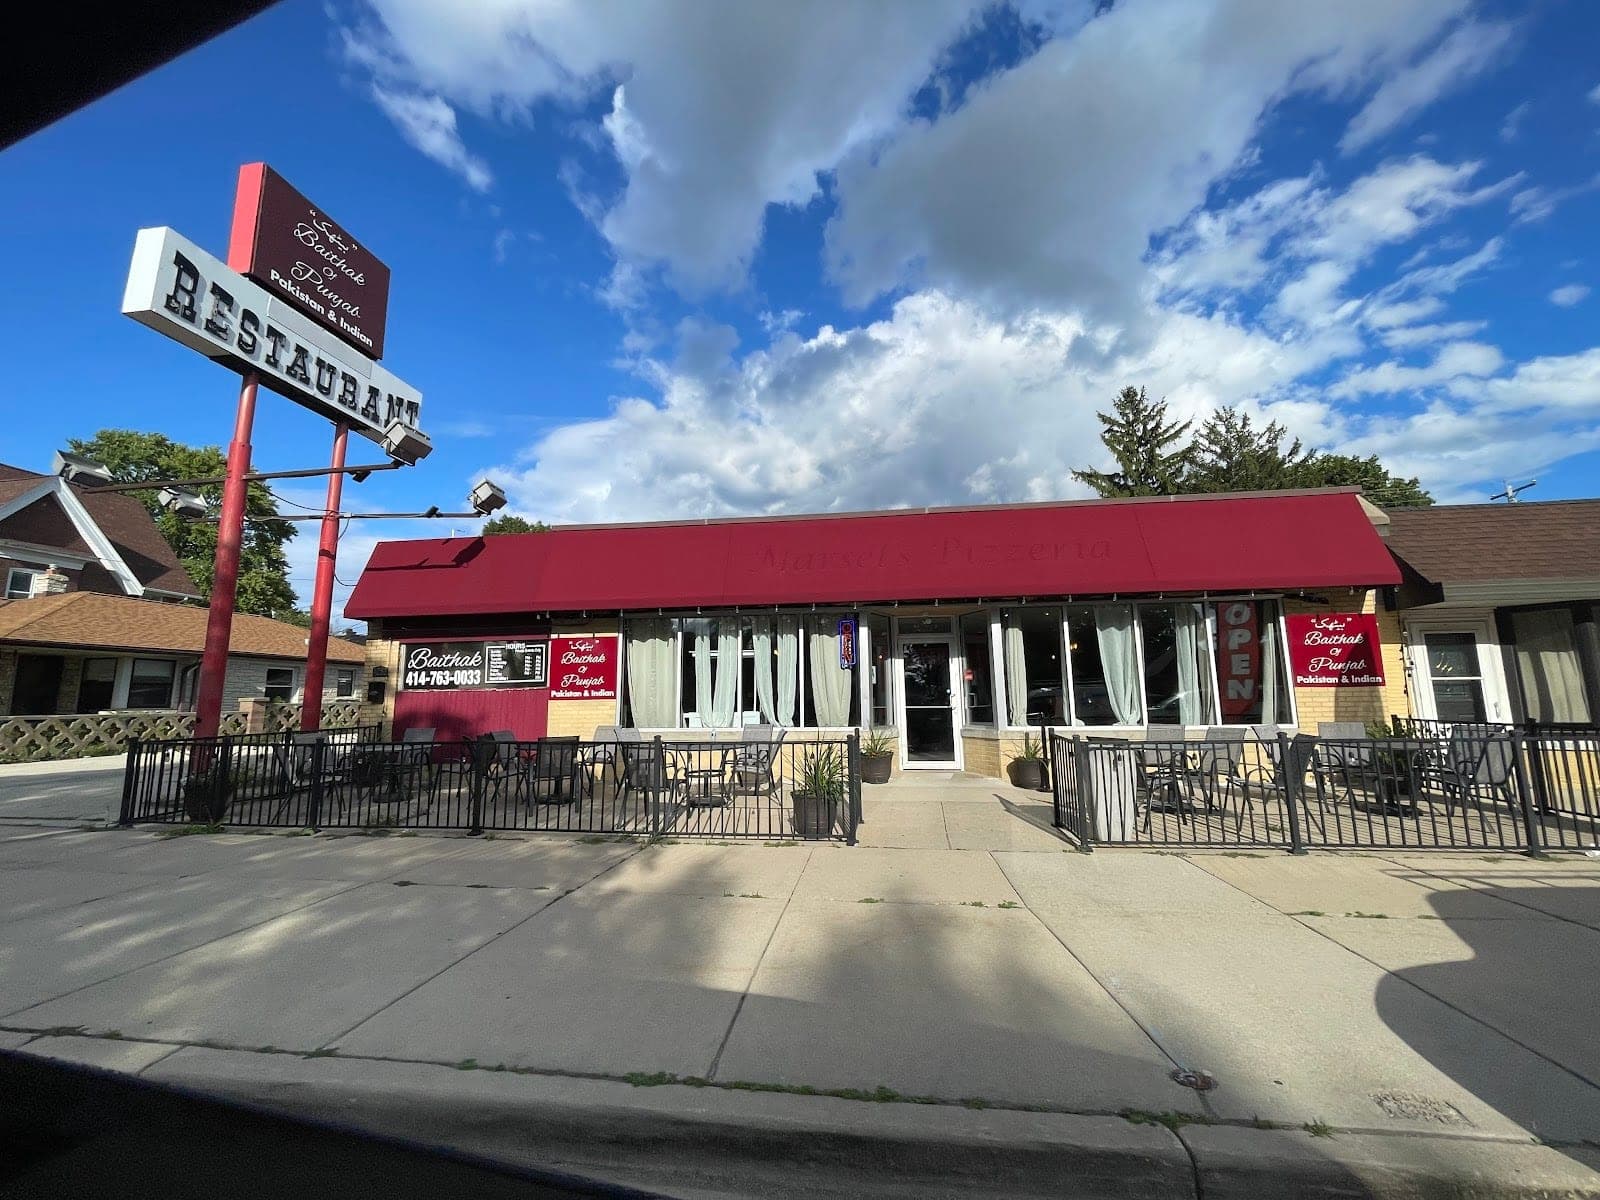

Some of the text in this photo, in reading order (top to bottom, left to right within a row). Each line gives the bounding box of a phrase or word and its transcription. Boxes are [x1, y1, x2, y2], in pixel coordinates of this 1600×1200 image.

[293, 222, 366, 286] Baithak
[322, 266, 338, 281] Of
[290, 261, 361, 318] Punjab
[270, 268, 373, 348] Pakistan & Indian
[164, 250, 420, 426] RESTAURANT
[1304, 631, 1365, 646] Baithak
[407, 648, 483, 669] Baithak
[561, 652, 606, 665] Baithak
[1225, 603, 1254, 700] OPEN
[1329, 648, 1342, 656] Of
[1308, 657, 1367, 674] Punjab
[405, 670, 481, 686] 414-763-0033
[561, 674, 605, 688] Punjab
[1297, 675, 1383, 684] Pakistan & Indian
[591, 689, 615, 697] Indian
